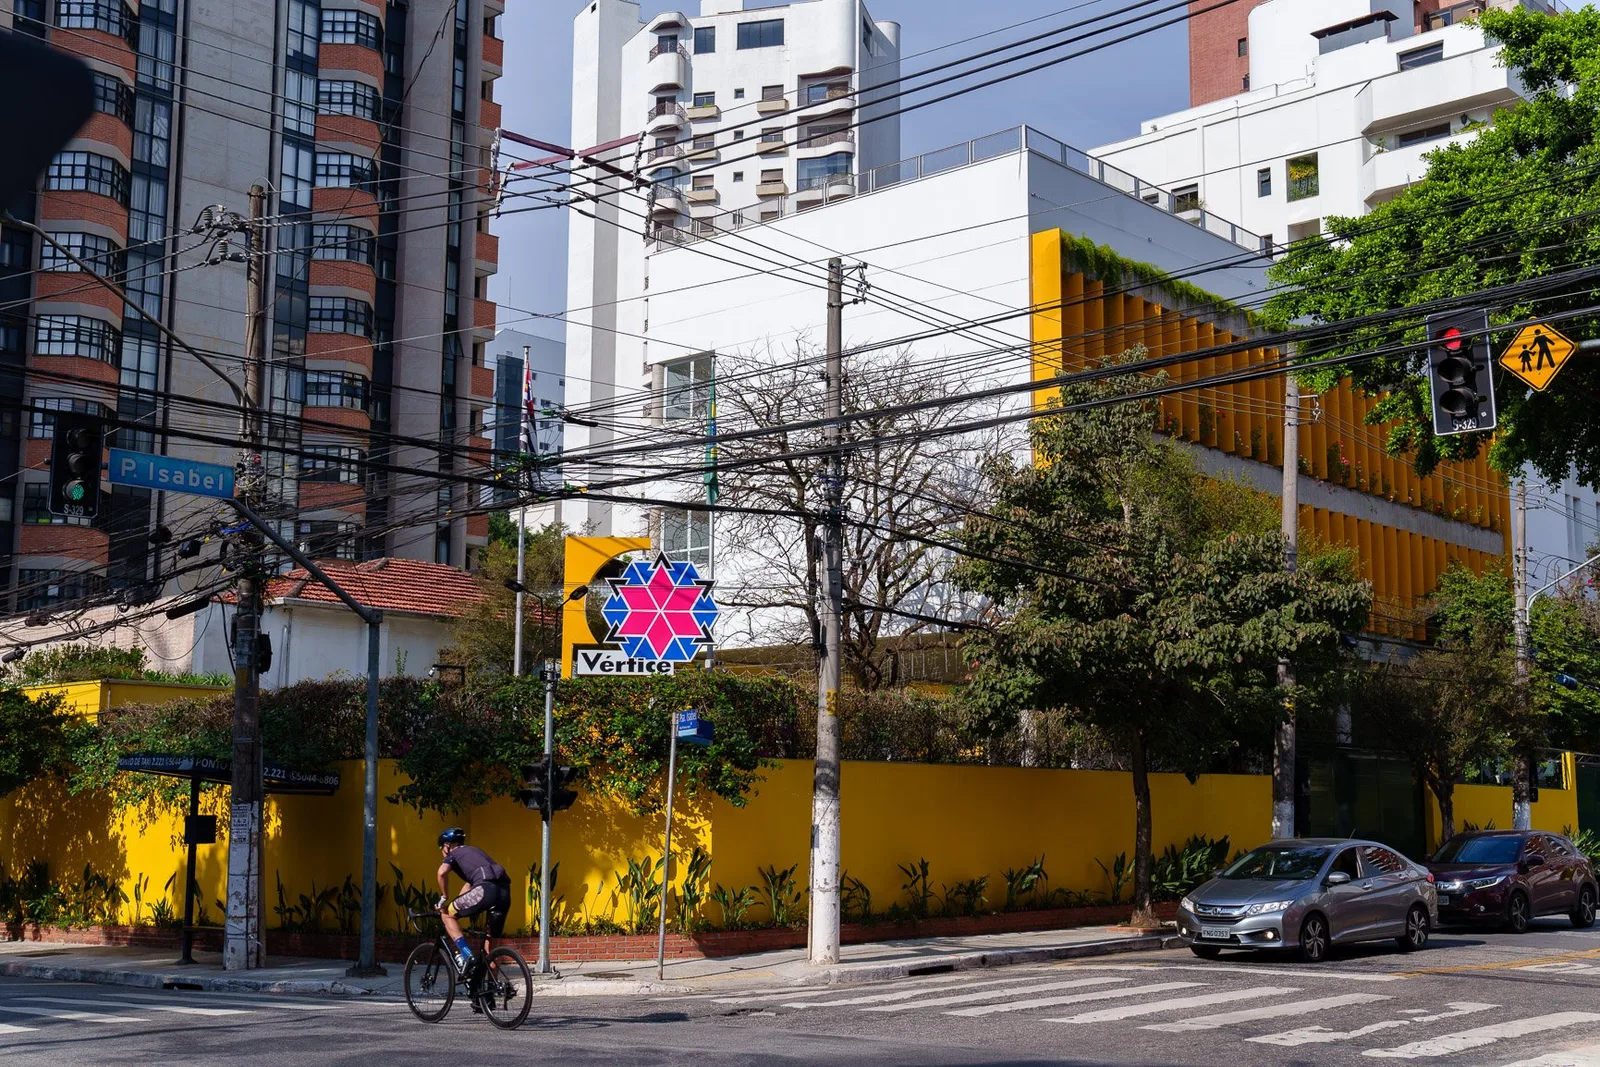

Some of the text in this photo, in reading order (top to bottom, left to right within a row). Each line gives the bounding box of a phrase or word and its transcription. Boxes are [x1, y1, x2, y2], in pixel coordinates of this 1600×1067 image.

[1452, 417, 1477, 430] S-329
[121, 458, 224, 491] P. Isabel
[63, 503, 84, 516] S-329
[581, 652, 671, 673] Vértice
[195, 757, 228, 770] PONTO
[263, 766, 287, 779] 2.221
